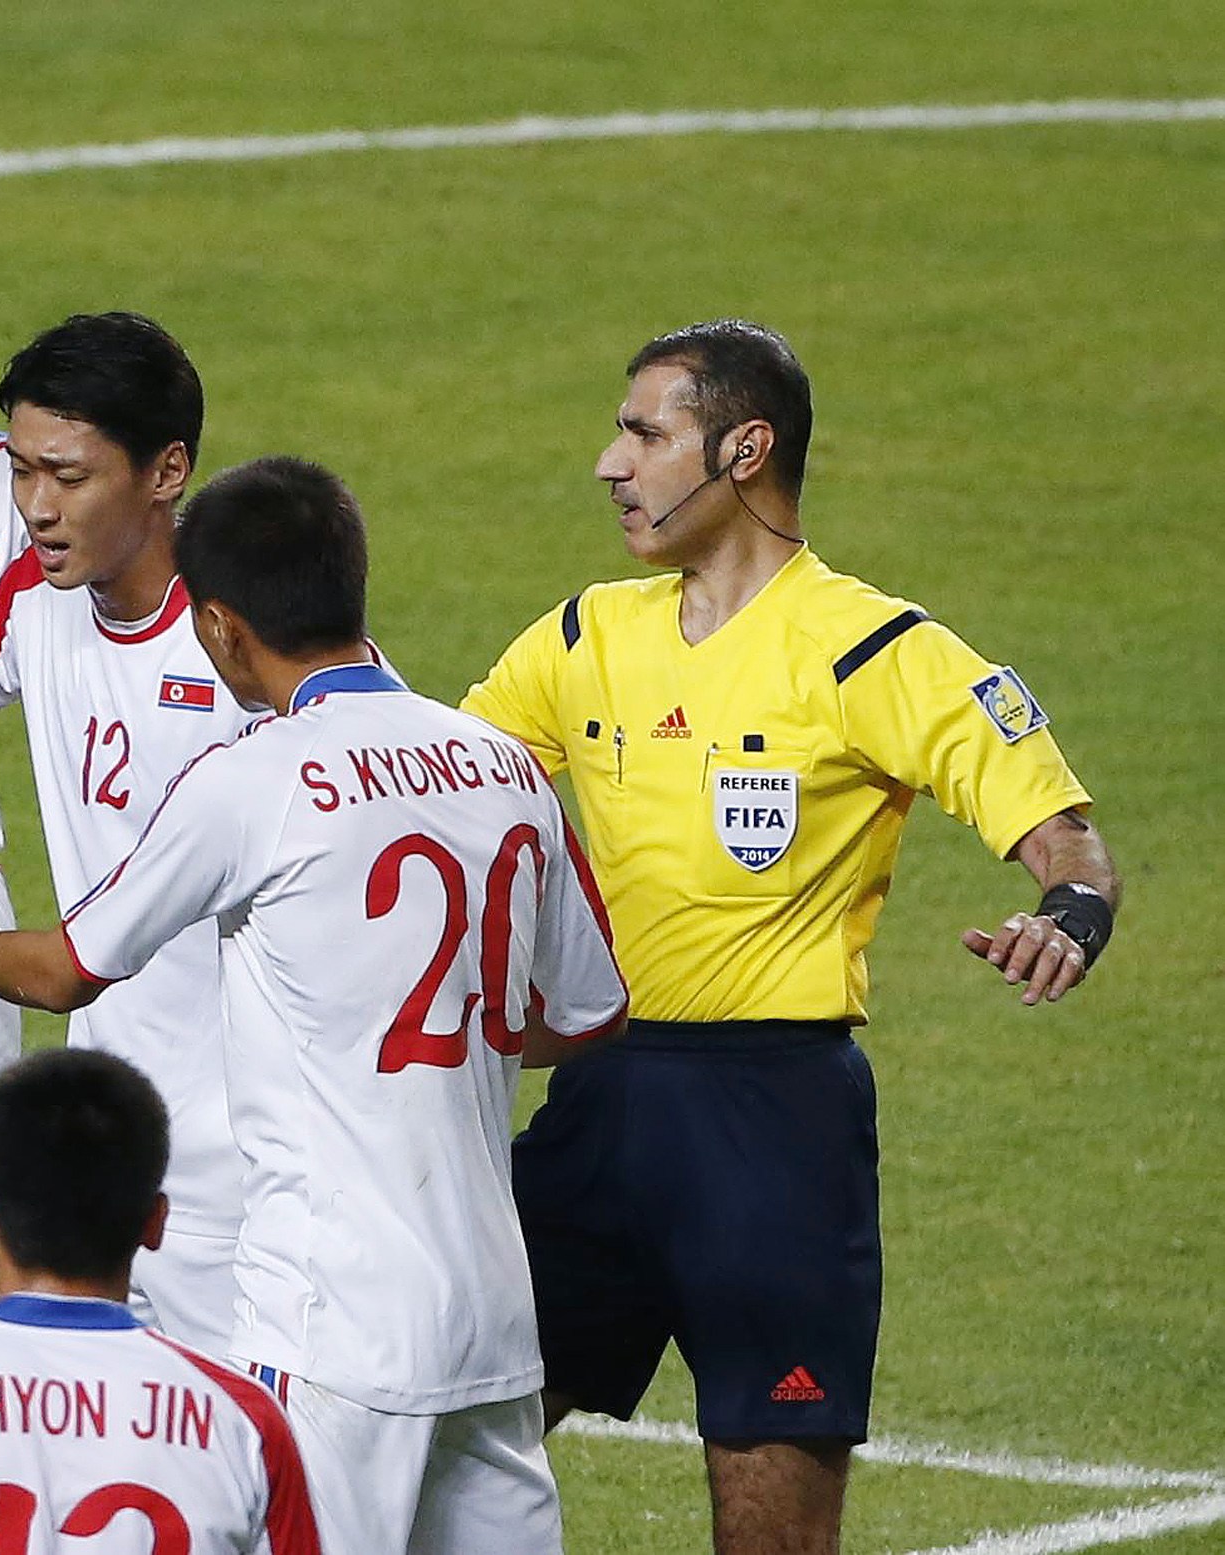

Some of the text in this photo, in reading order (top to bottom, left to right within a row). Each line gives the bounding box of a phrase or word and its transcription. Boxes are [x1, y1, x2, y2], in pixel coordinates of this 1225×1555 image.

[651, 727, 692, 739] adidas
[82, 716, 130, 811] 12
[300, 738, 538, 813] S.KYONG JIN
[720, 777, 790, 791] REFEREE
[725, 807, 786, 828] FIFA
[740, 850, 770, 862] 2014
[365, 823, 545, 1073] 20
[771, 1388, 824, 1401] adidas
[131, 1381, 212, 1449] JIN
